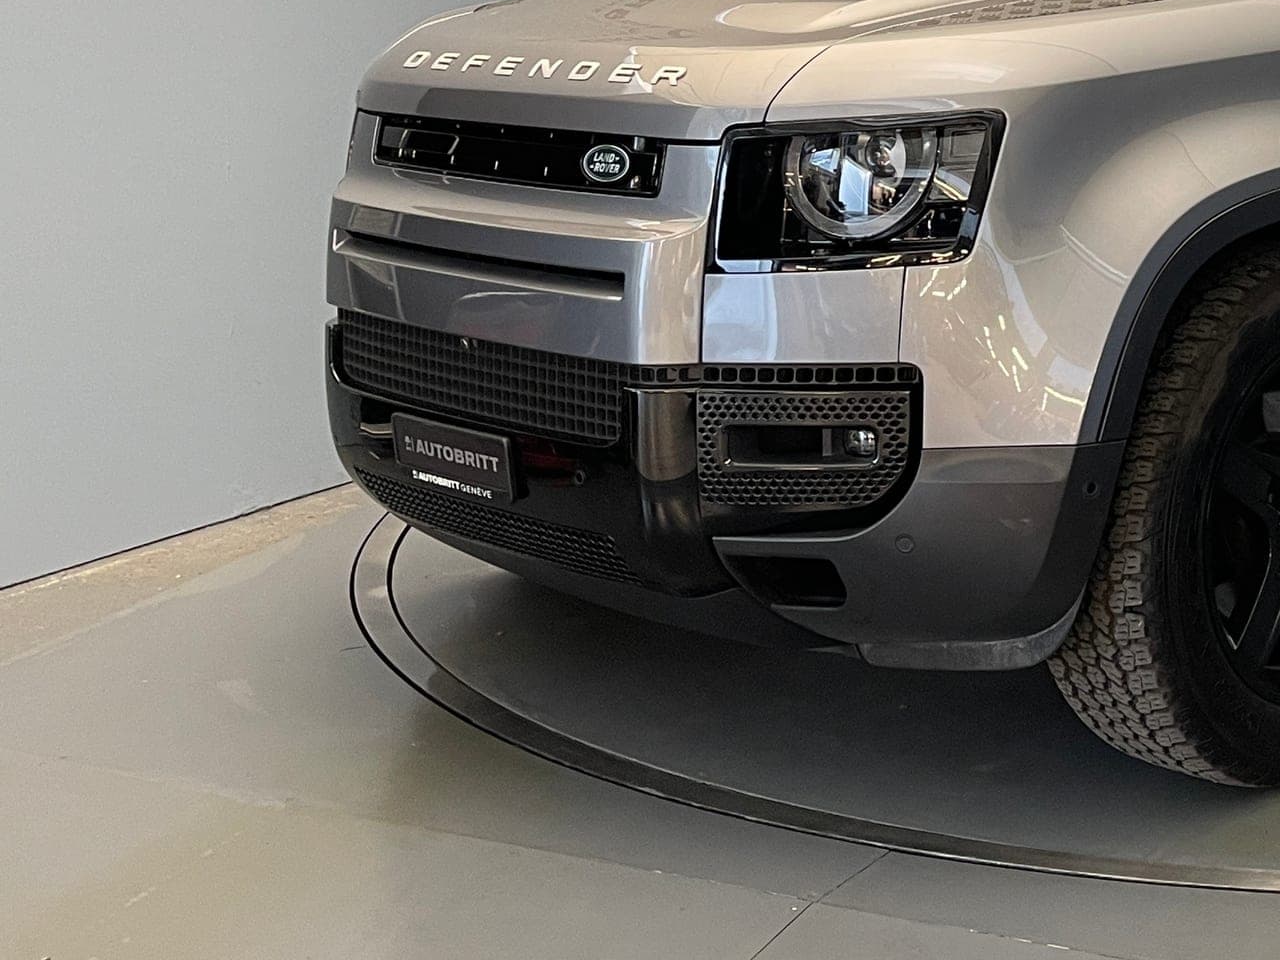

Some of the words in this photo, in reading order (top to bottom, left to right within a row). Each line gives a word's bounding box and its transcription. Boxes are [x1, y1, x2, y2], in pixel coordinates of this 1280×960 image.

[403, 51, 687, 85] DEFENDER
[416, 439, 498, 472] AUTOBRITT
[418, 471, 460, 490] AUTOBRITT
